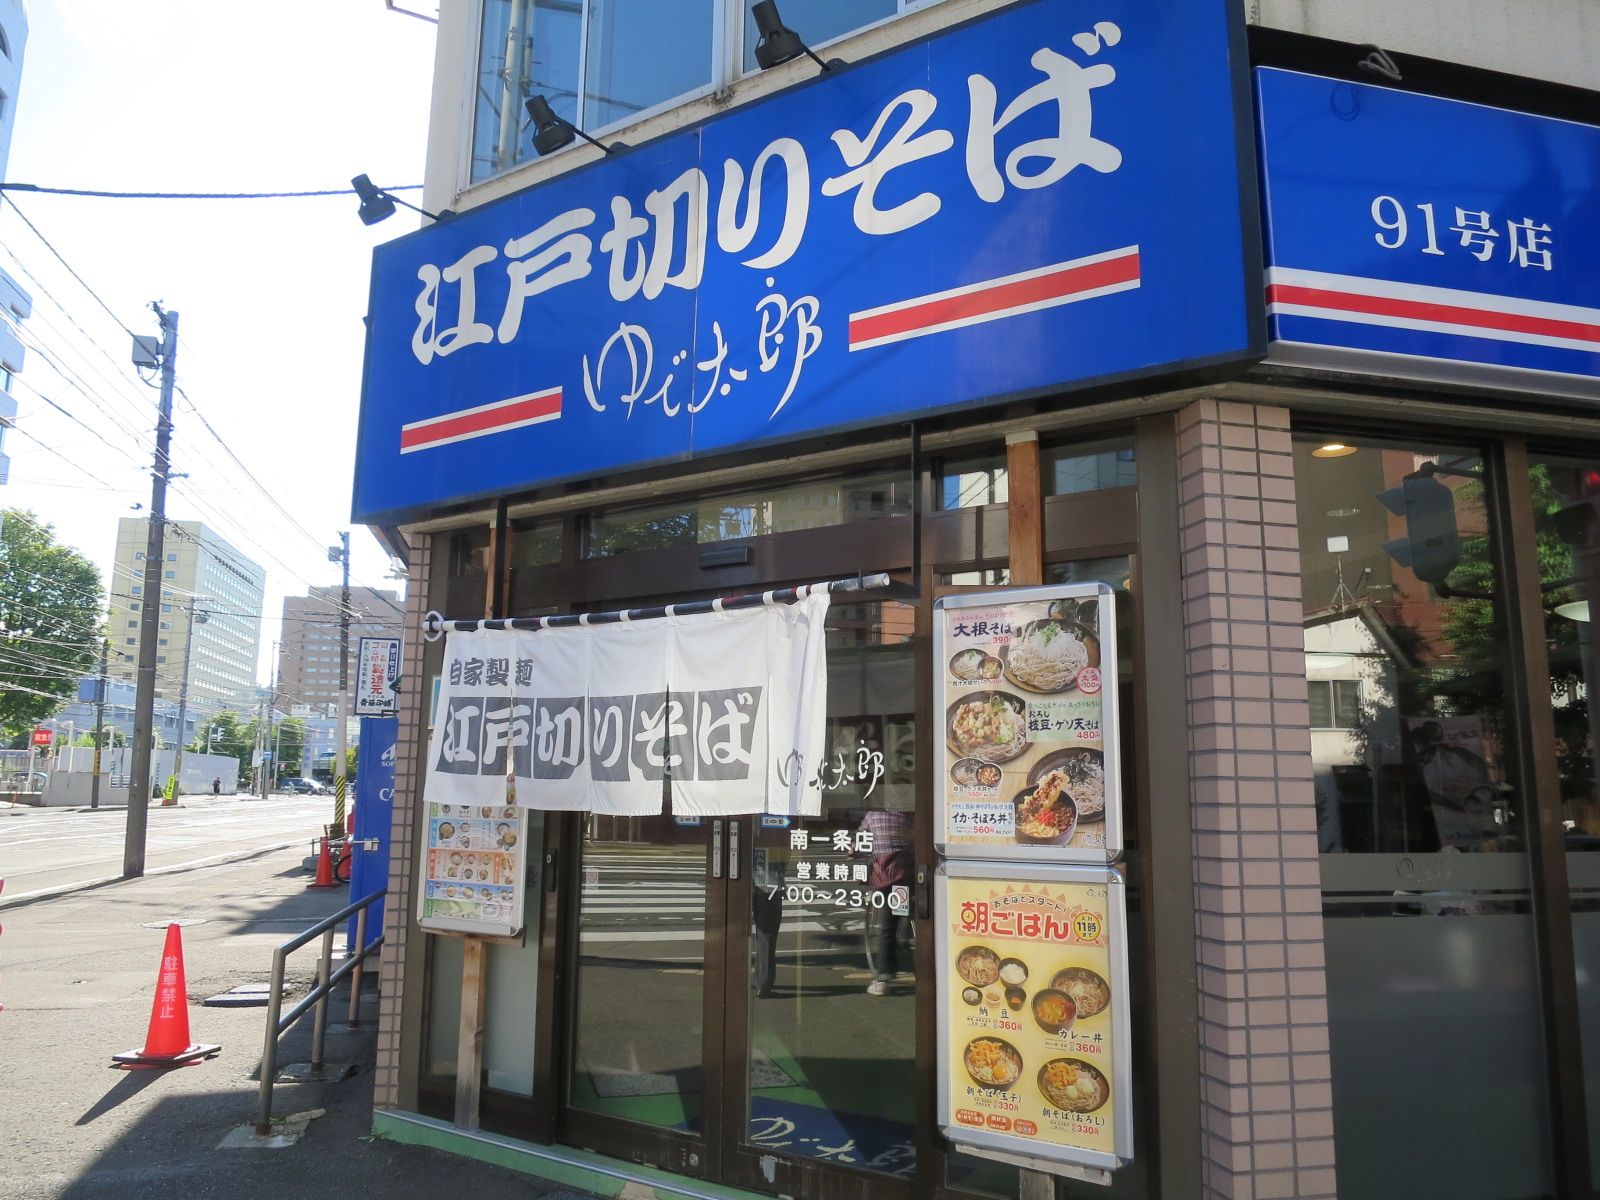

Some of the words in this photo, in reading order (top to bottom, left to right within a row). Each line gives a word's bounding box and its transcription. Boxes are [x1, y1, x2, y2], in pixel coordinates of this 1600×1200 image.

[411, 21, 1122, 366] 江戸切りそば
[1371, 195, 1552, 271] 91号店
[582, 276, 823, 421] ゆで太郎
[449, 657, 534, 687] 自家製麺
[443, 692, 754, 767] 江戸切りそば
[1028, 710, 1050, 718] おろし
[790, 829, 874, 852] 南一条店
[796, 861, 868, 882] 営業時間
[960, 901, 1069, 940] 朝ごはん
[1077, 921, 1097, 932] 11時
[160, 956, 178, 1019] 駐車禁止
